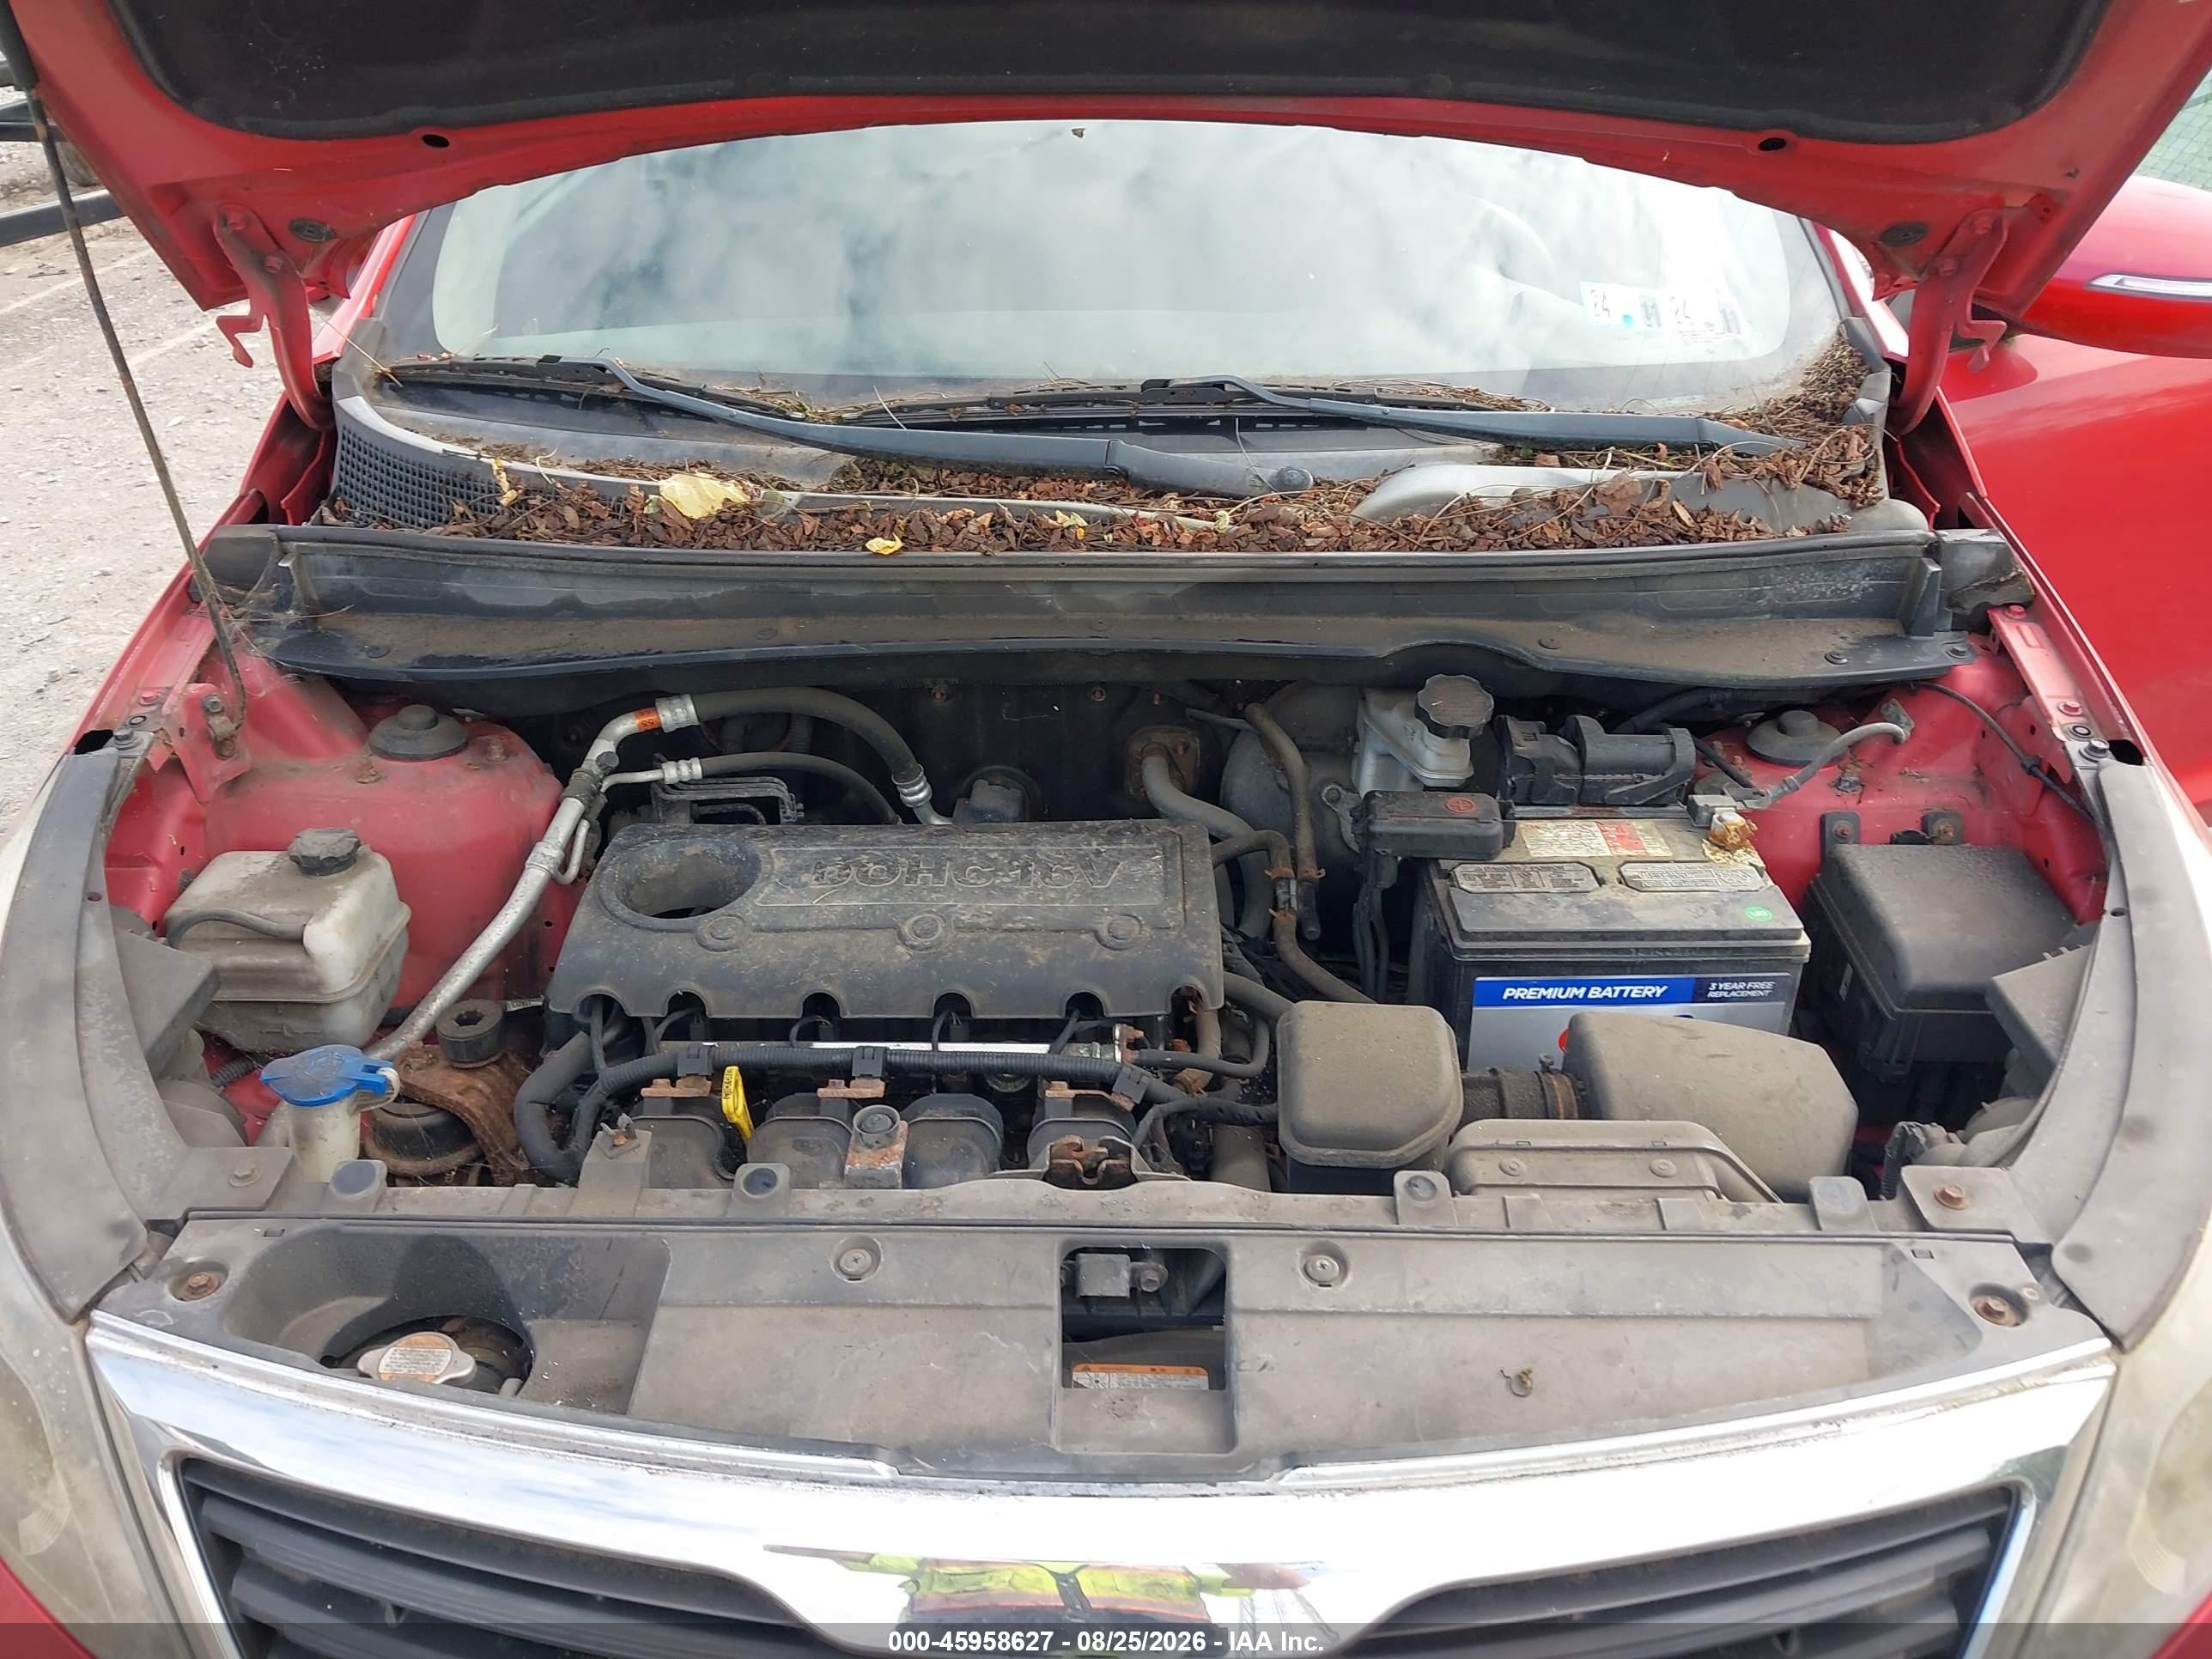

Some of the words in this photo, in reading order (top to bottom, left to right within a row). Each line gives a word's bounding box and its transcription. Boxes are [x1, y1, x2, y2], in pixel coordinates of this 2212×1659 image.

[810, 860, 995, 888] DOHC
[1011, 860, 1126, 889] 16V
[1717, 981, 1747, 990] YEAR
[1746, 981, 1777, 990] FREE
[1502, 986, 1588, 1000] PREMIUM
[1587, 985, 1669, 999] BATTERY
[1707, 989, 1773, 999] REPLACEMENT
